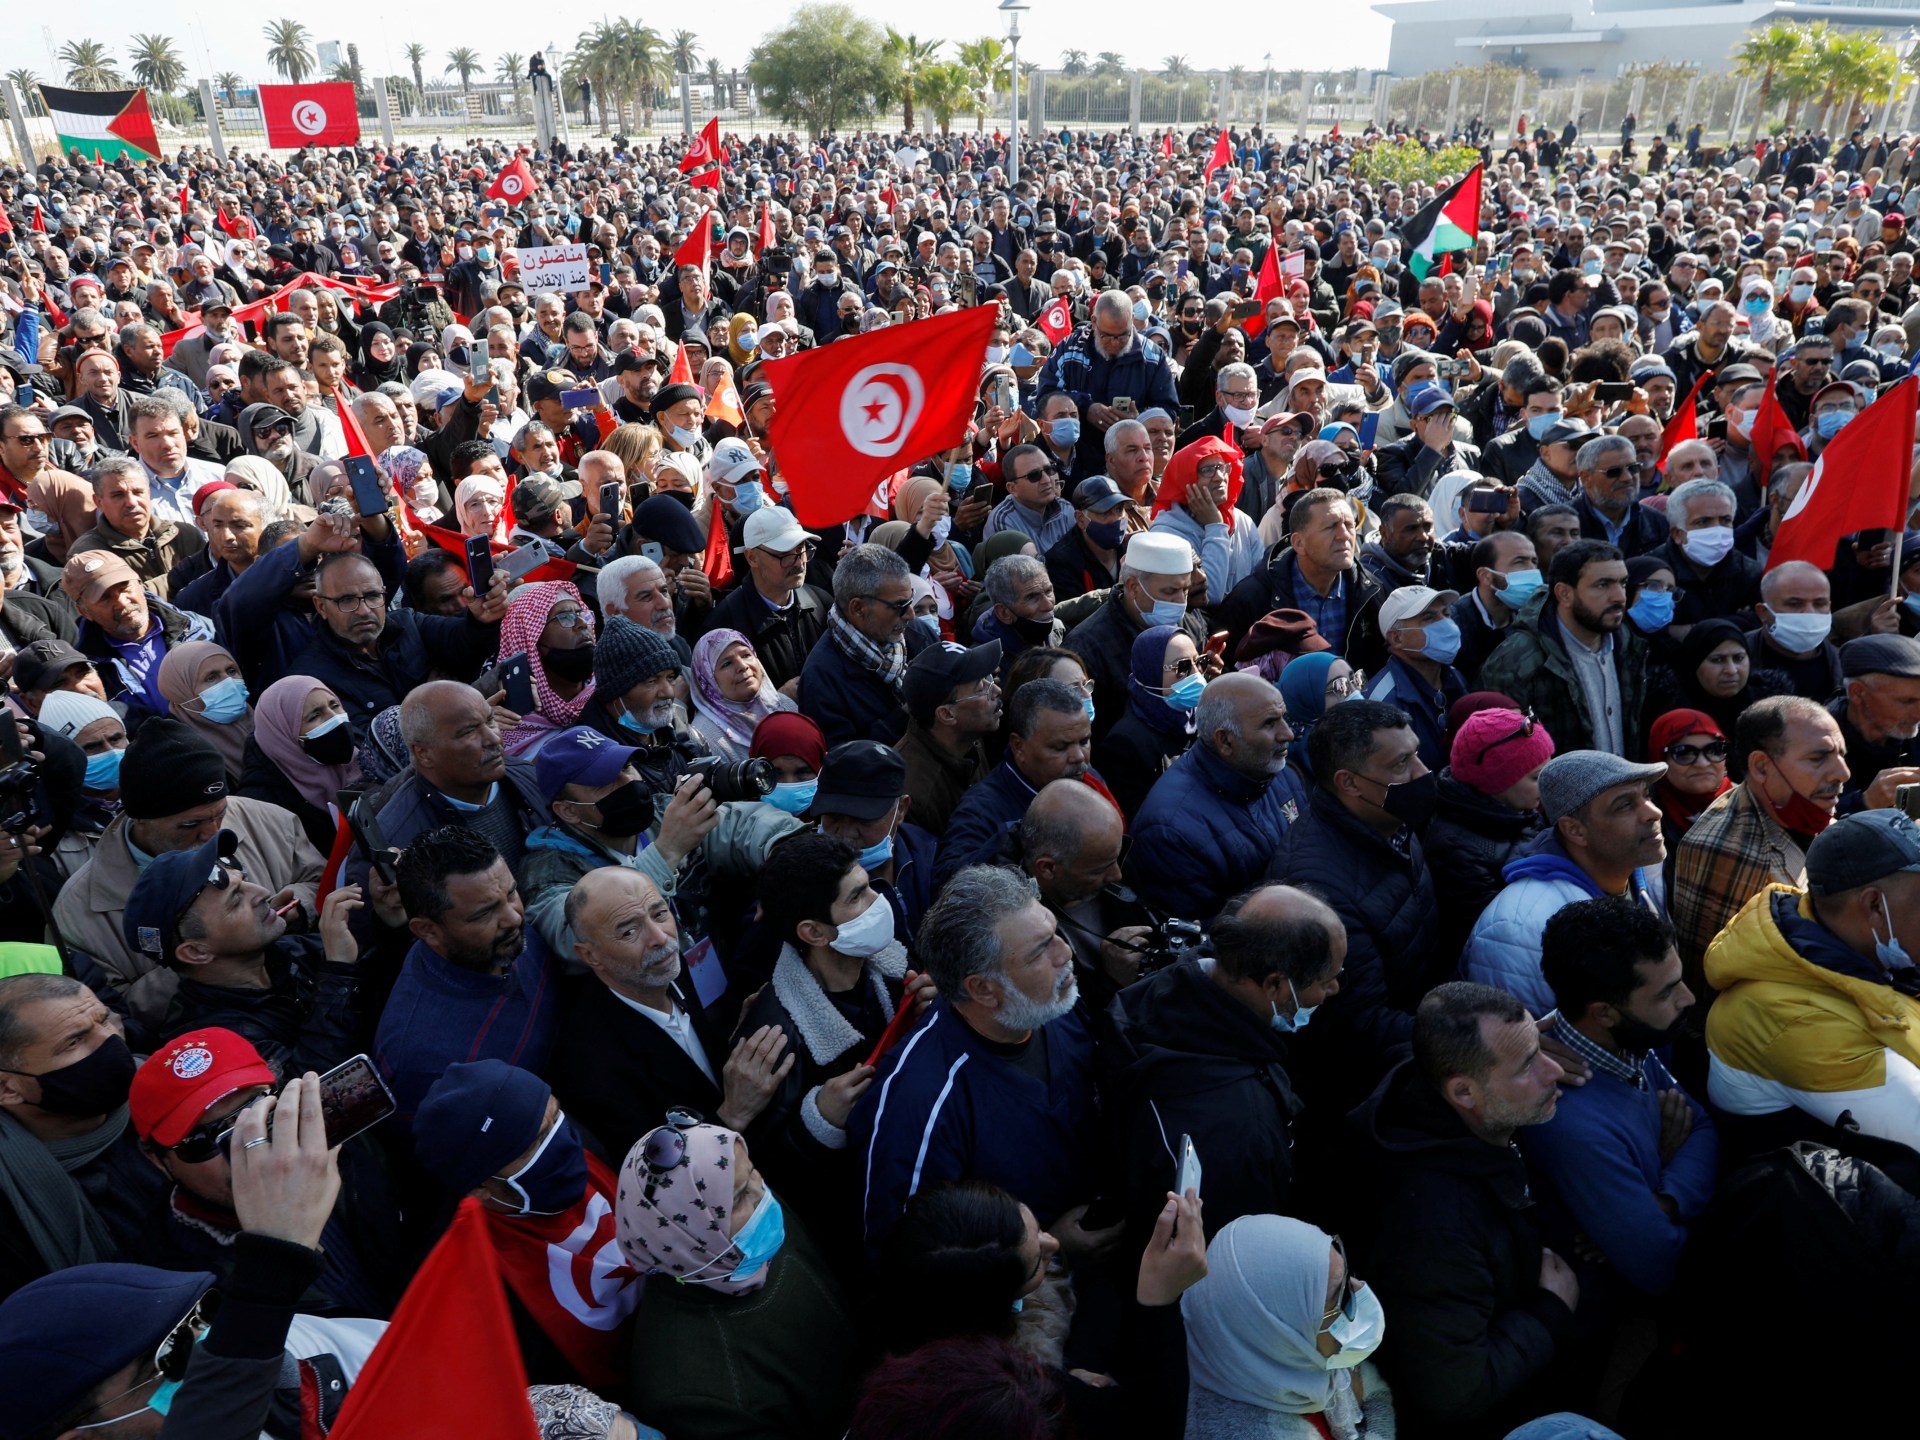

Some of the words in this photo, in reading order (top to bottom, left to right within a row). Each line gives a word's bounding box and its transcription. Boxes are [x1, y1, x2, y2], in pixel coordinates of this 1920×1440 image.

[524, 248, 583, 270] مناضلون
[527, 273, 566, 291] الانقلاب
[728, 449, 748, 463] NY
[37, 641, 65, 661] NY
[576, 730, 606, 750] NY
